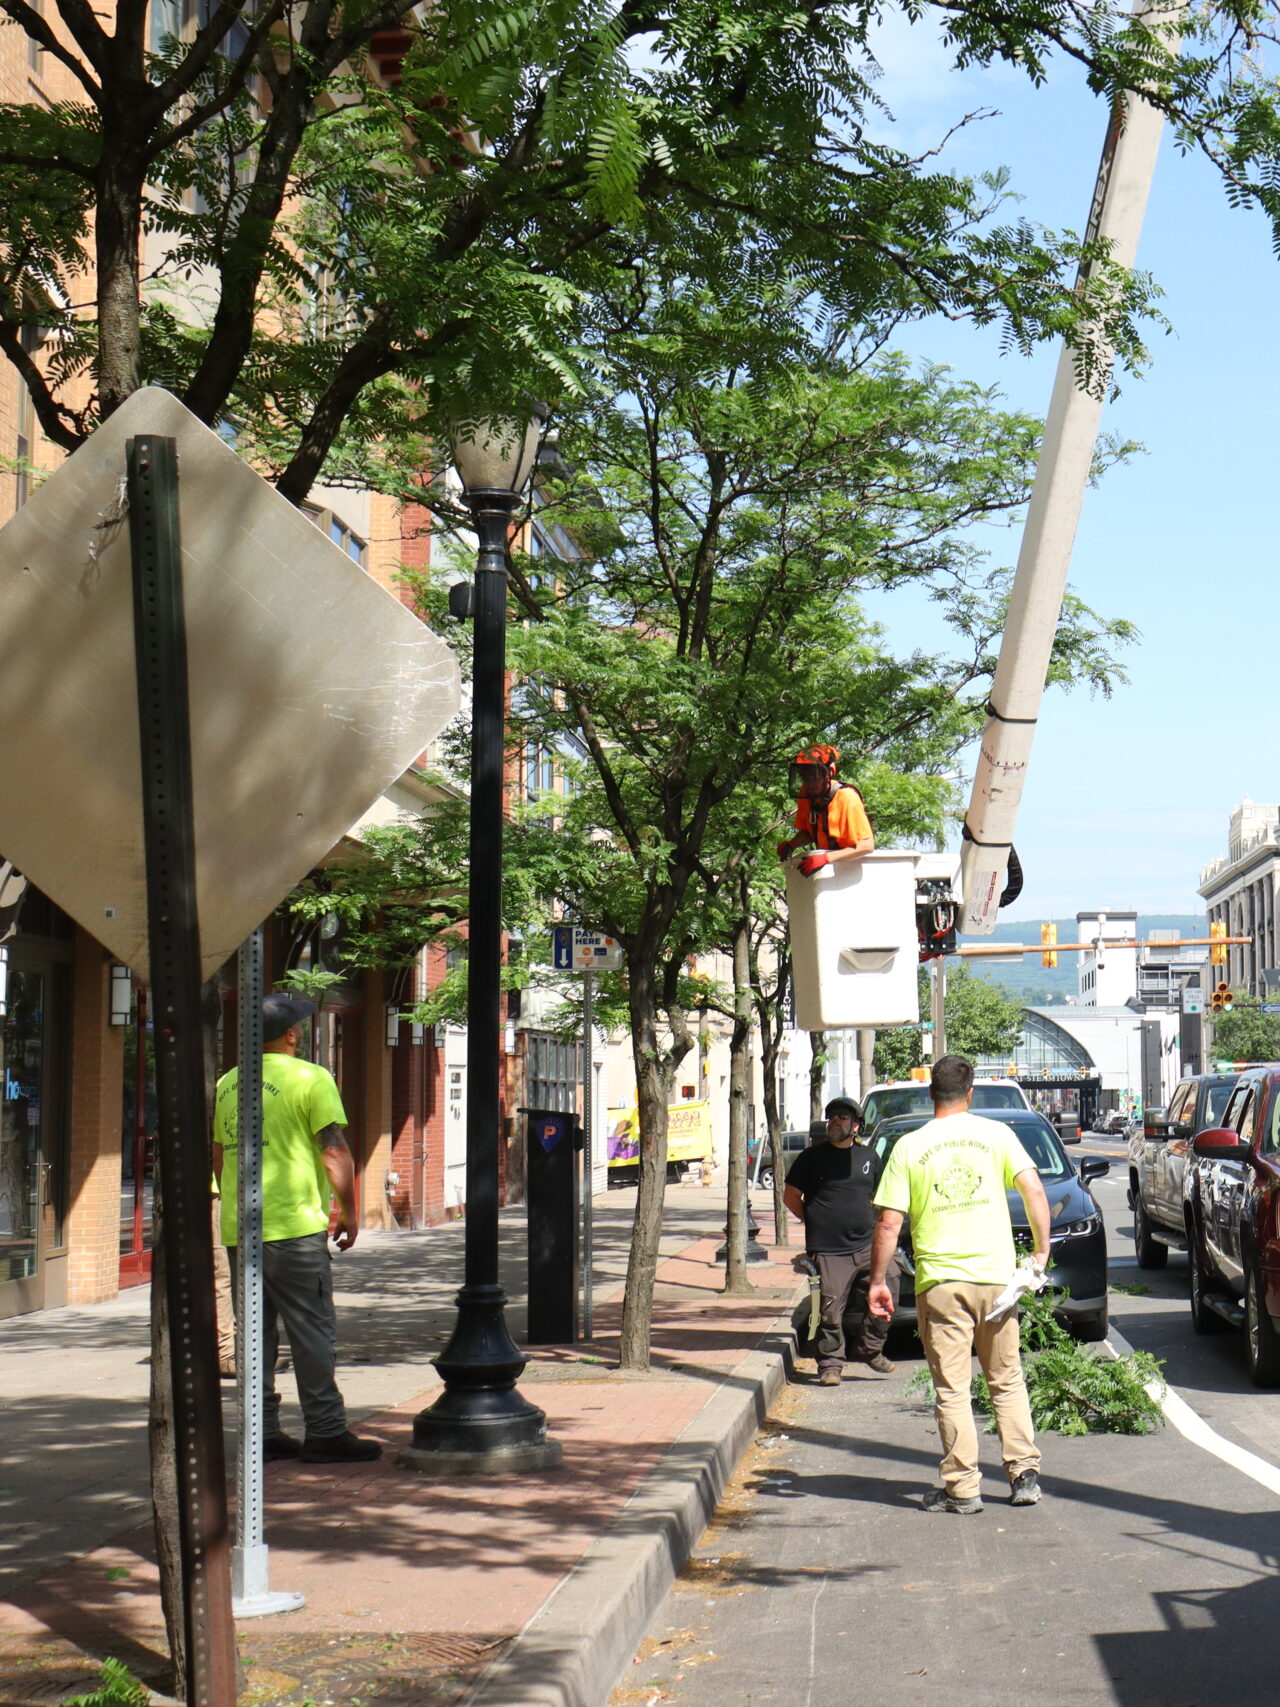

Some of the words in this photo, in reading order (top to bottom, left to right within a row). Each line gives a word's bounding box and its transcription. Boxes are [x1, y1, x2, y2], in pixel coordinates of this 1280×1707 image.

[544, 1125, 557, 1139] P
[944, 1140, 966, 1148] PUBLIC
[968, 1140, 990, 1153] WORKS
